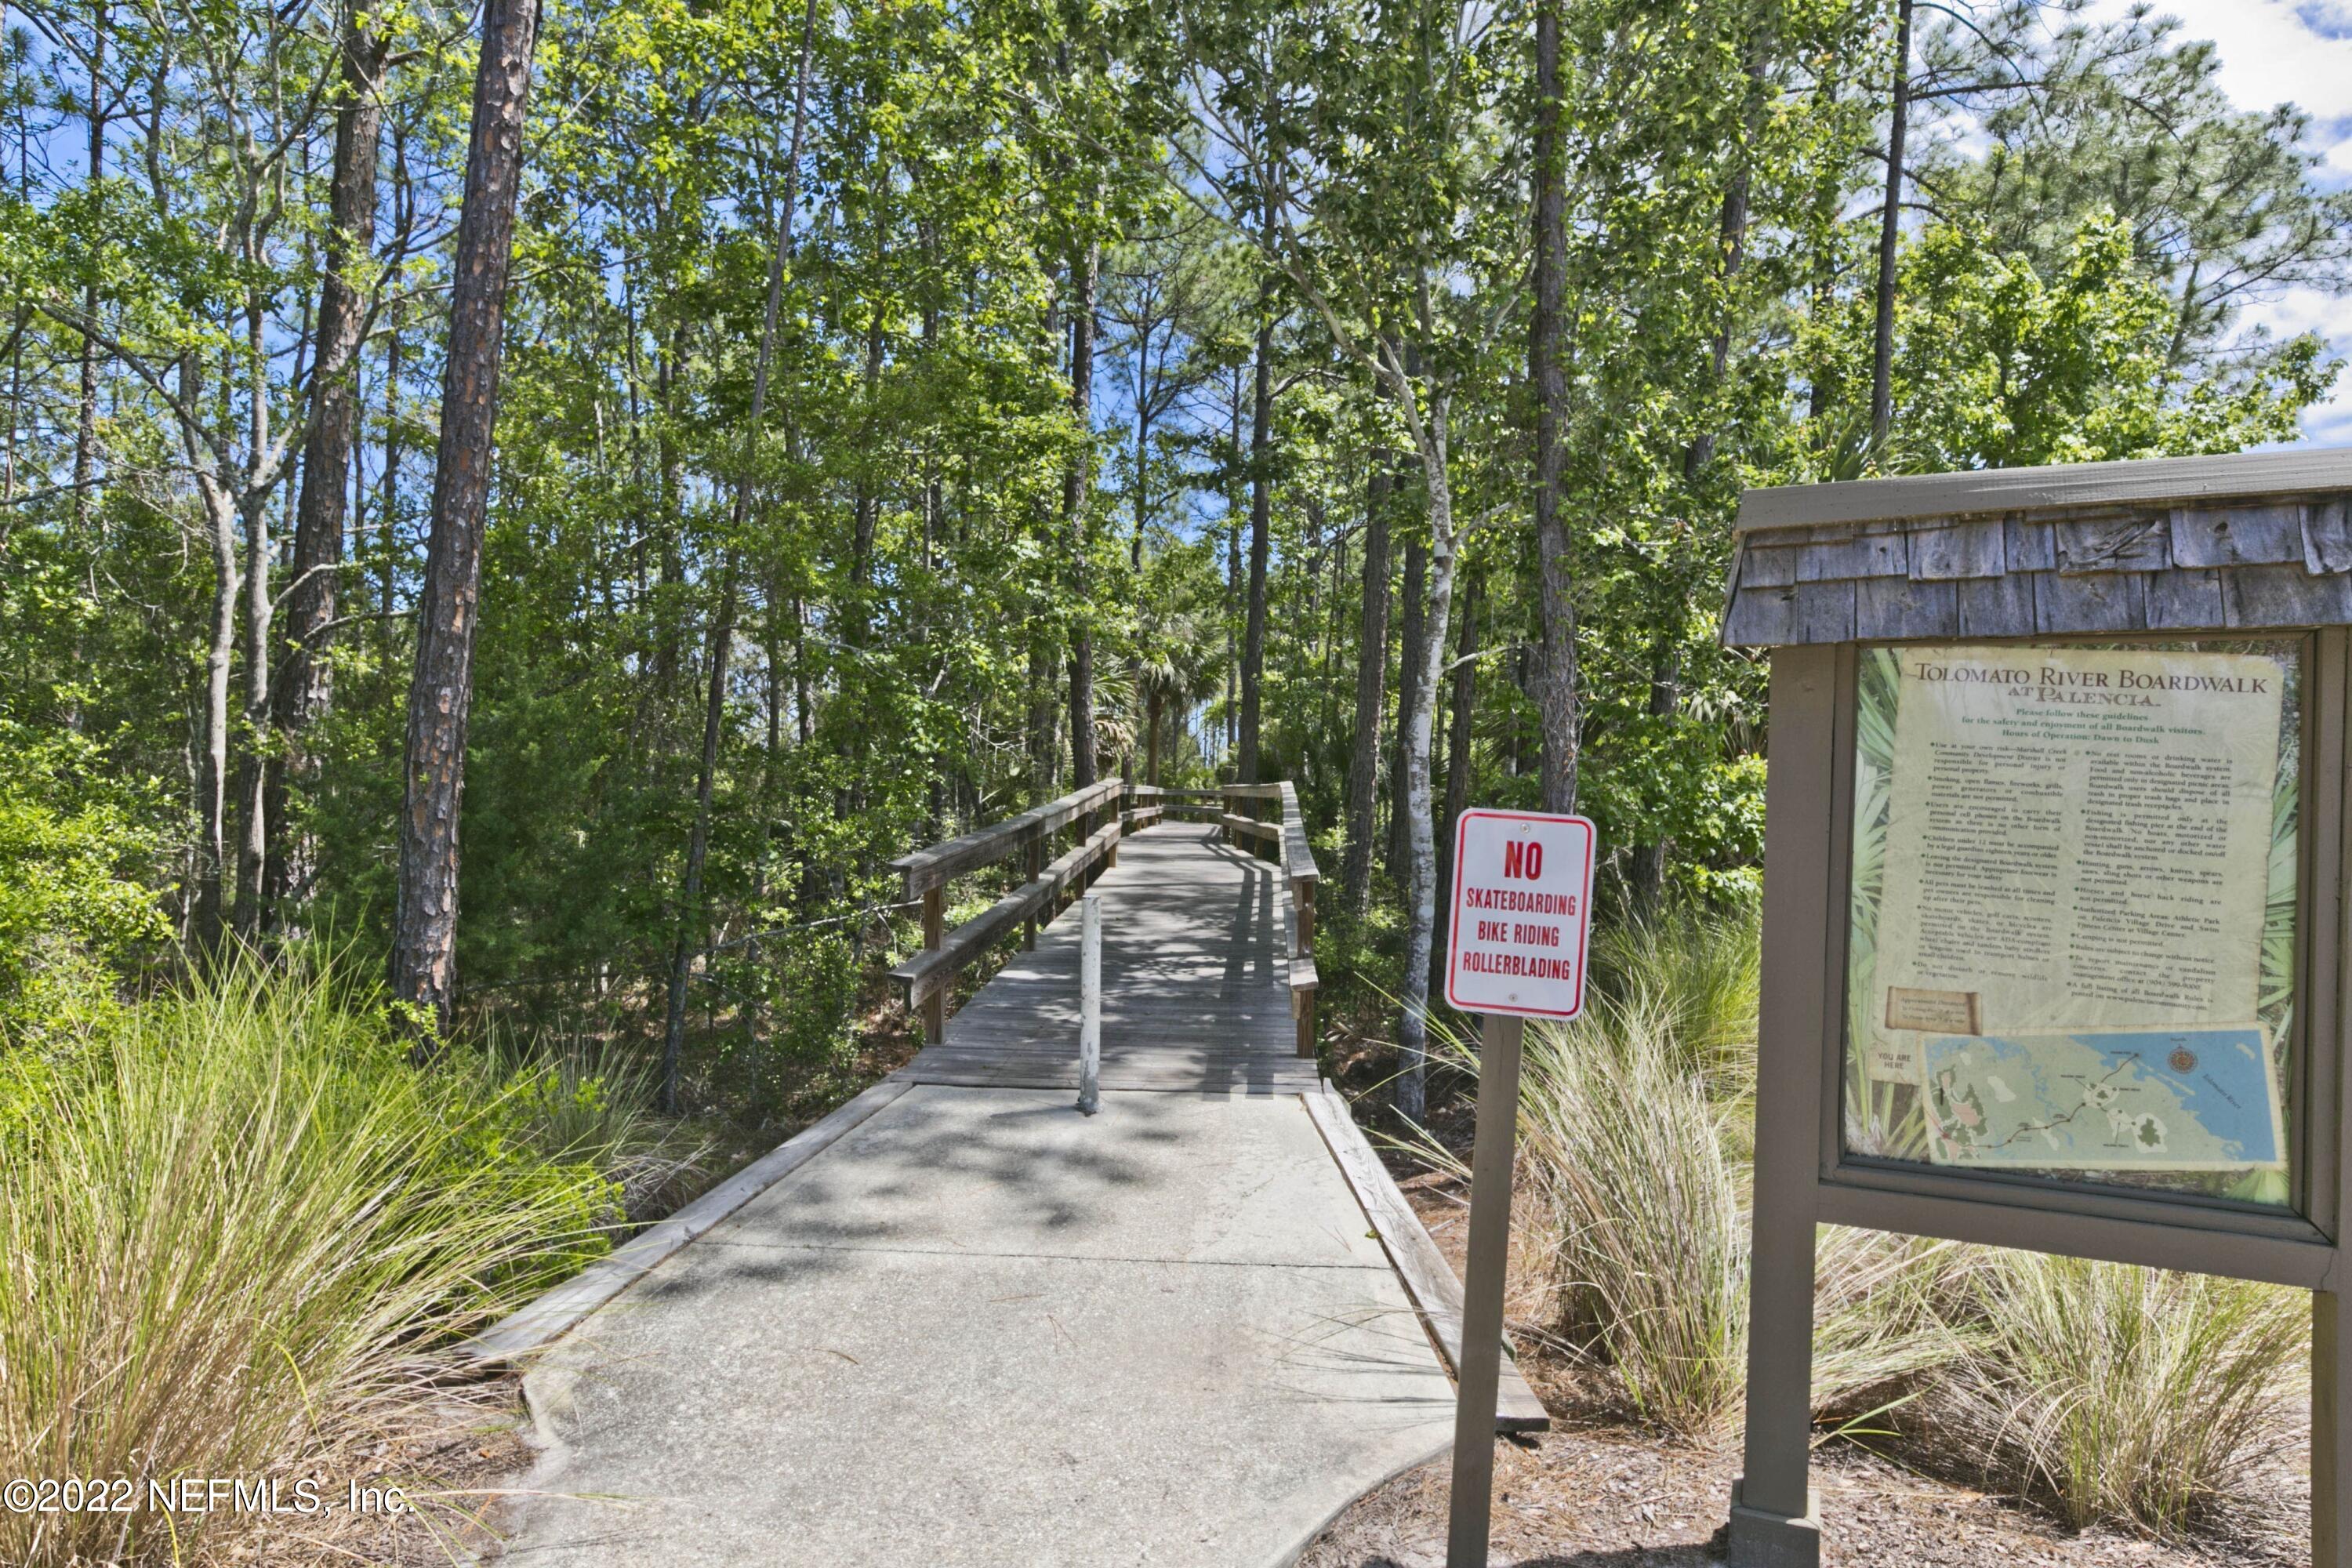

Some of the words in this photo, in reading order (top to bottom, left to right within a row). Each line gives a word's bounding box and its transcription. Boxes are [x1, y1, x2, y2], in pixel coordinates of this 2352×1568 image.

[1915, 662, 2031, 684] TOLOMATO
[2039, 667, 2109, 688] RIVER
[2119, 670, 2269, 695] BOARDWALK
[2008, 686, 2034, 696] AT
[2036, 687, 2153, 706] PALENCIA
[1993, 717, 2020, 727] safety
[2040, 720, 2086, 730] enjoyment
[2115, 724, 2165, 733] Boardwalk
[2169, 727, 2206, 735] visitors.
[2045, 709, 2074, 717] follow
[2043, 731, 2091, 741] Operation:
[2136, 735, 2160, 744] Dusk
[1504, 840, 1543, 880] NO
[1466, 887, 1576, 916] SKATEBOARDING
[1478, 920, 1508, 942] BIKE
[1514, 924, 1559, 946] RIDING
[1463, 951, 1570, 980] ROLLERBLADING
